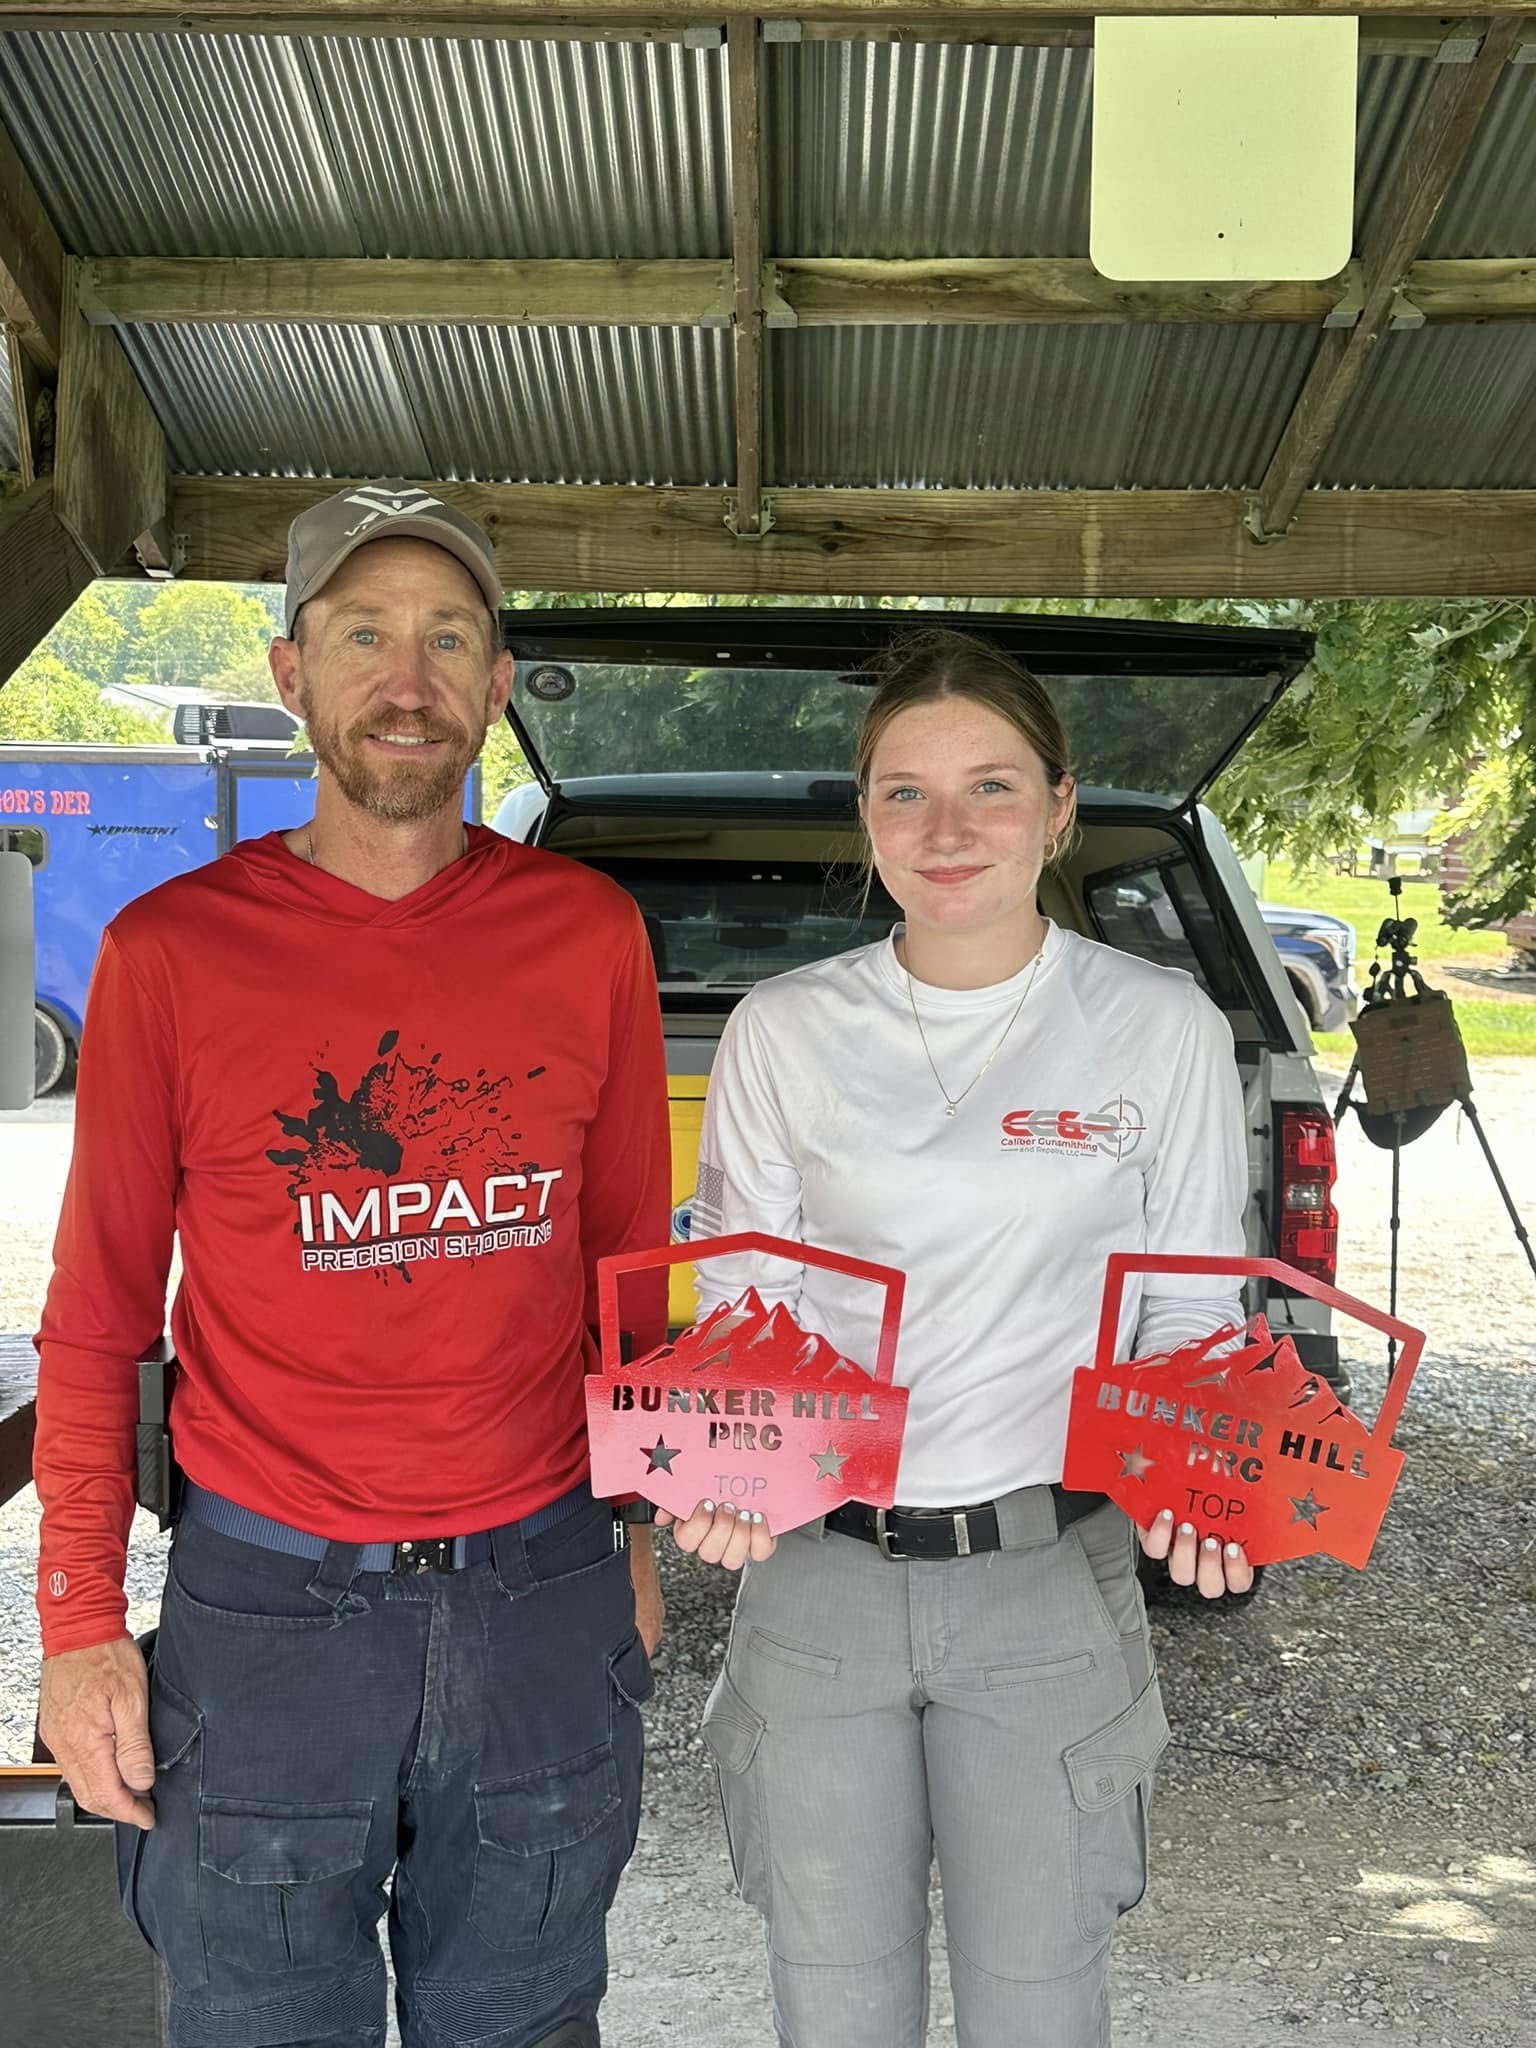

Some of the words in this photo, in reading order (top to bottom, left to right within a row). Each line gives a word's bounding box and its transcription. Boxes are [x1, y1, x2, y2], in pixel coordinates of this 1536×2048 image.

[1001, 1138, 1036, 1146] Caliber
[1038, 1137, 1098, 1152] Gunsmithing
[1036, 1146, 1065, 1155] Repairs,
[1066, 1149, 1080, 1157] LLC
[299, 1169, 563, 1242] IMPACT
[302, 1240, 440, 1271] PRECISION
[444, 1219, 553, 1259] SHOOTING
[612, 1385, 775, 1417] BUNKER
[792, 1391, 880, 1421] HILL
[708, 1421, 783, 1452] PRC
[1097, 1382, 1264, 1449] BUNKER
[1279, 1430, 1371, 1480] HILL
[1186, 1442, 1265, 1483] PRC
[713, 1475, 768, 1497] TOP
[1185, 1488, 1246, 1521] TOP
